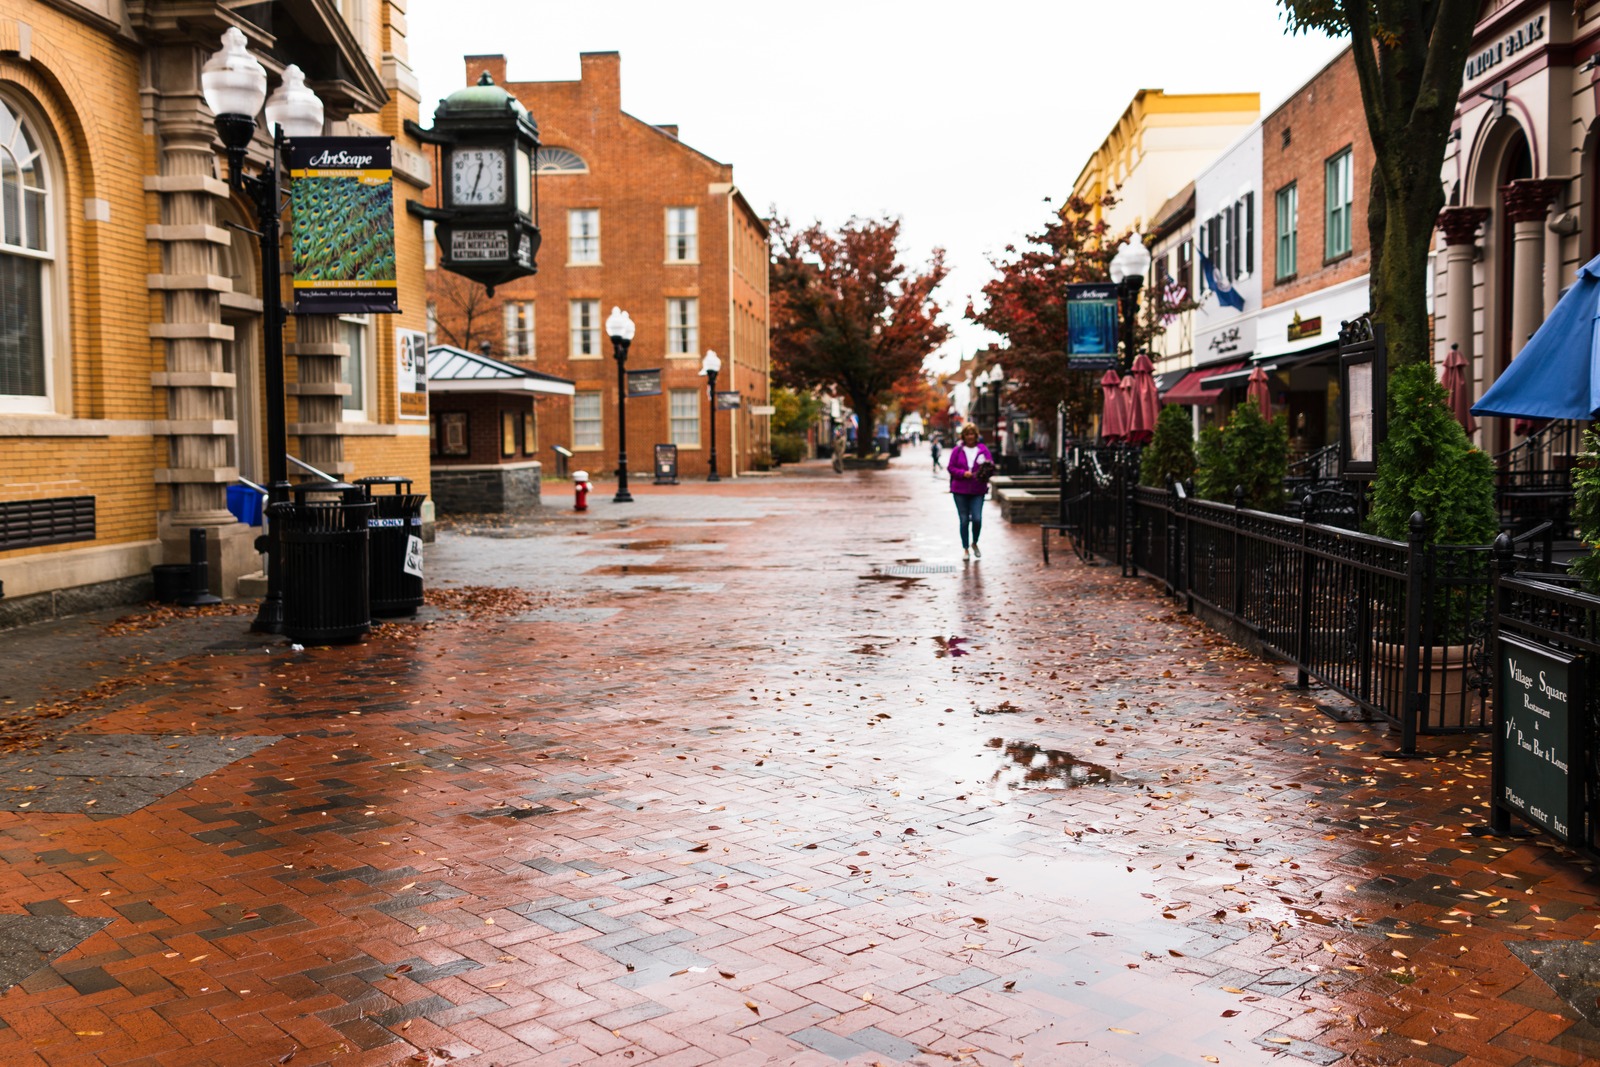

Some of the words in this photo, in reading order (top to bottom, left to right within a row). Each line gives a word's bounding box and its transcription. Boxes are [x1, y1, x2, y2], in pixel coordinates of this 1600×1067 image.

[1505, 15, 1544, 56] BANK
[309, 150, 372, 168] ArtScape
[475, 152, 483, 160] 12
[455, 161, 464, 169] 10
[497, 161, 503, 169] 2
[455, 173, 461, 181] 9
[497, 173, 503, 181] 3
[455, 185, 461, 193] 8
[497, 185, 503, 193] 4
[465, 193, 470, 201] 7
[462, 231, 497, 240] FARMERS
[453, 240, 465, 249] AND
[468, 240, 507, 249] MERCHANTS
[454, 250, 485, 258] NATIONAL
[489, 250, 507, 258] BANK
[381, 519, 403, 527] ONLY
[1508, 658, 1533, 689] Village
[1539, 670, 1567, 703] Square
[1524, 693, 1551, 718] Restaurant
[1517, 730, 1532, 752] Piano
[1533, 738, 1544, 758] Bar
[1551, 747, 1568, 775] Loung
[1505, 786, 1525, 809] Please
[1530, 805, 1548, 823] enter
